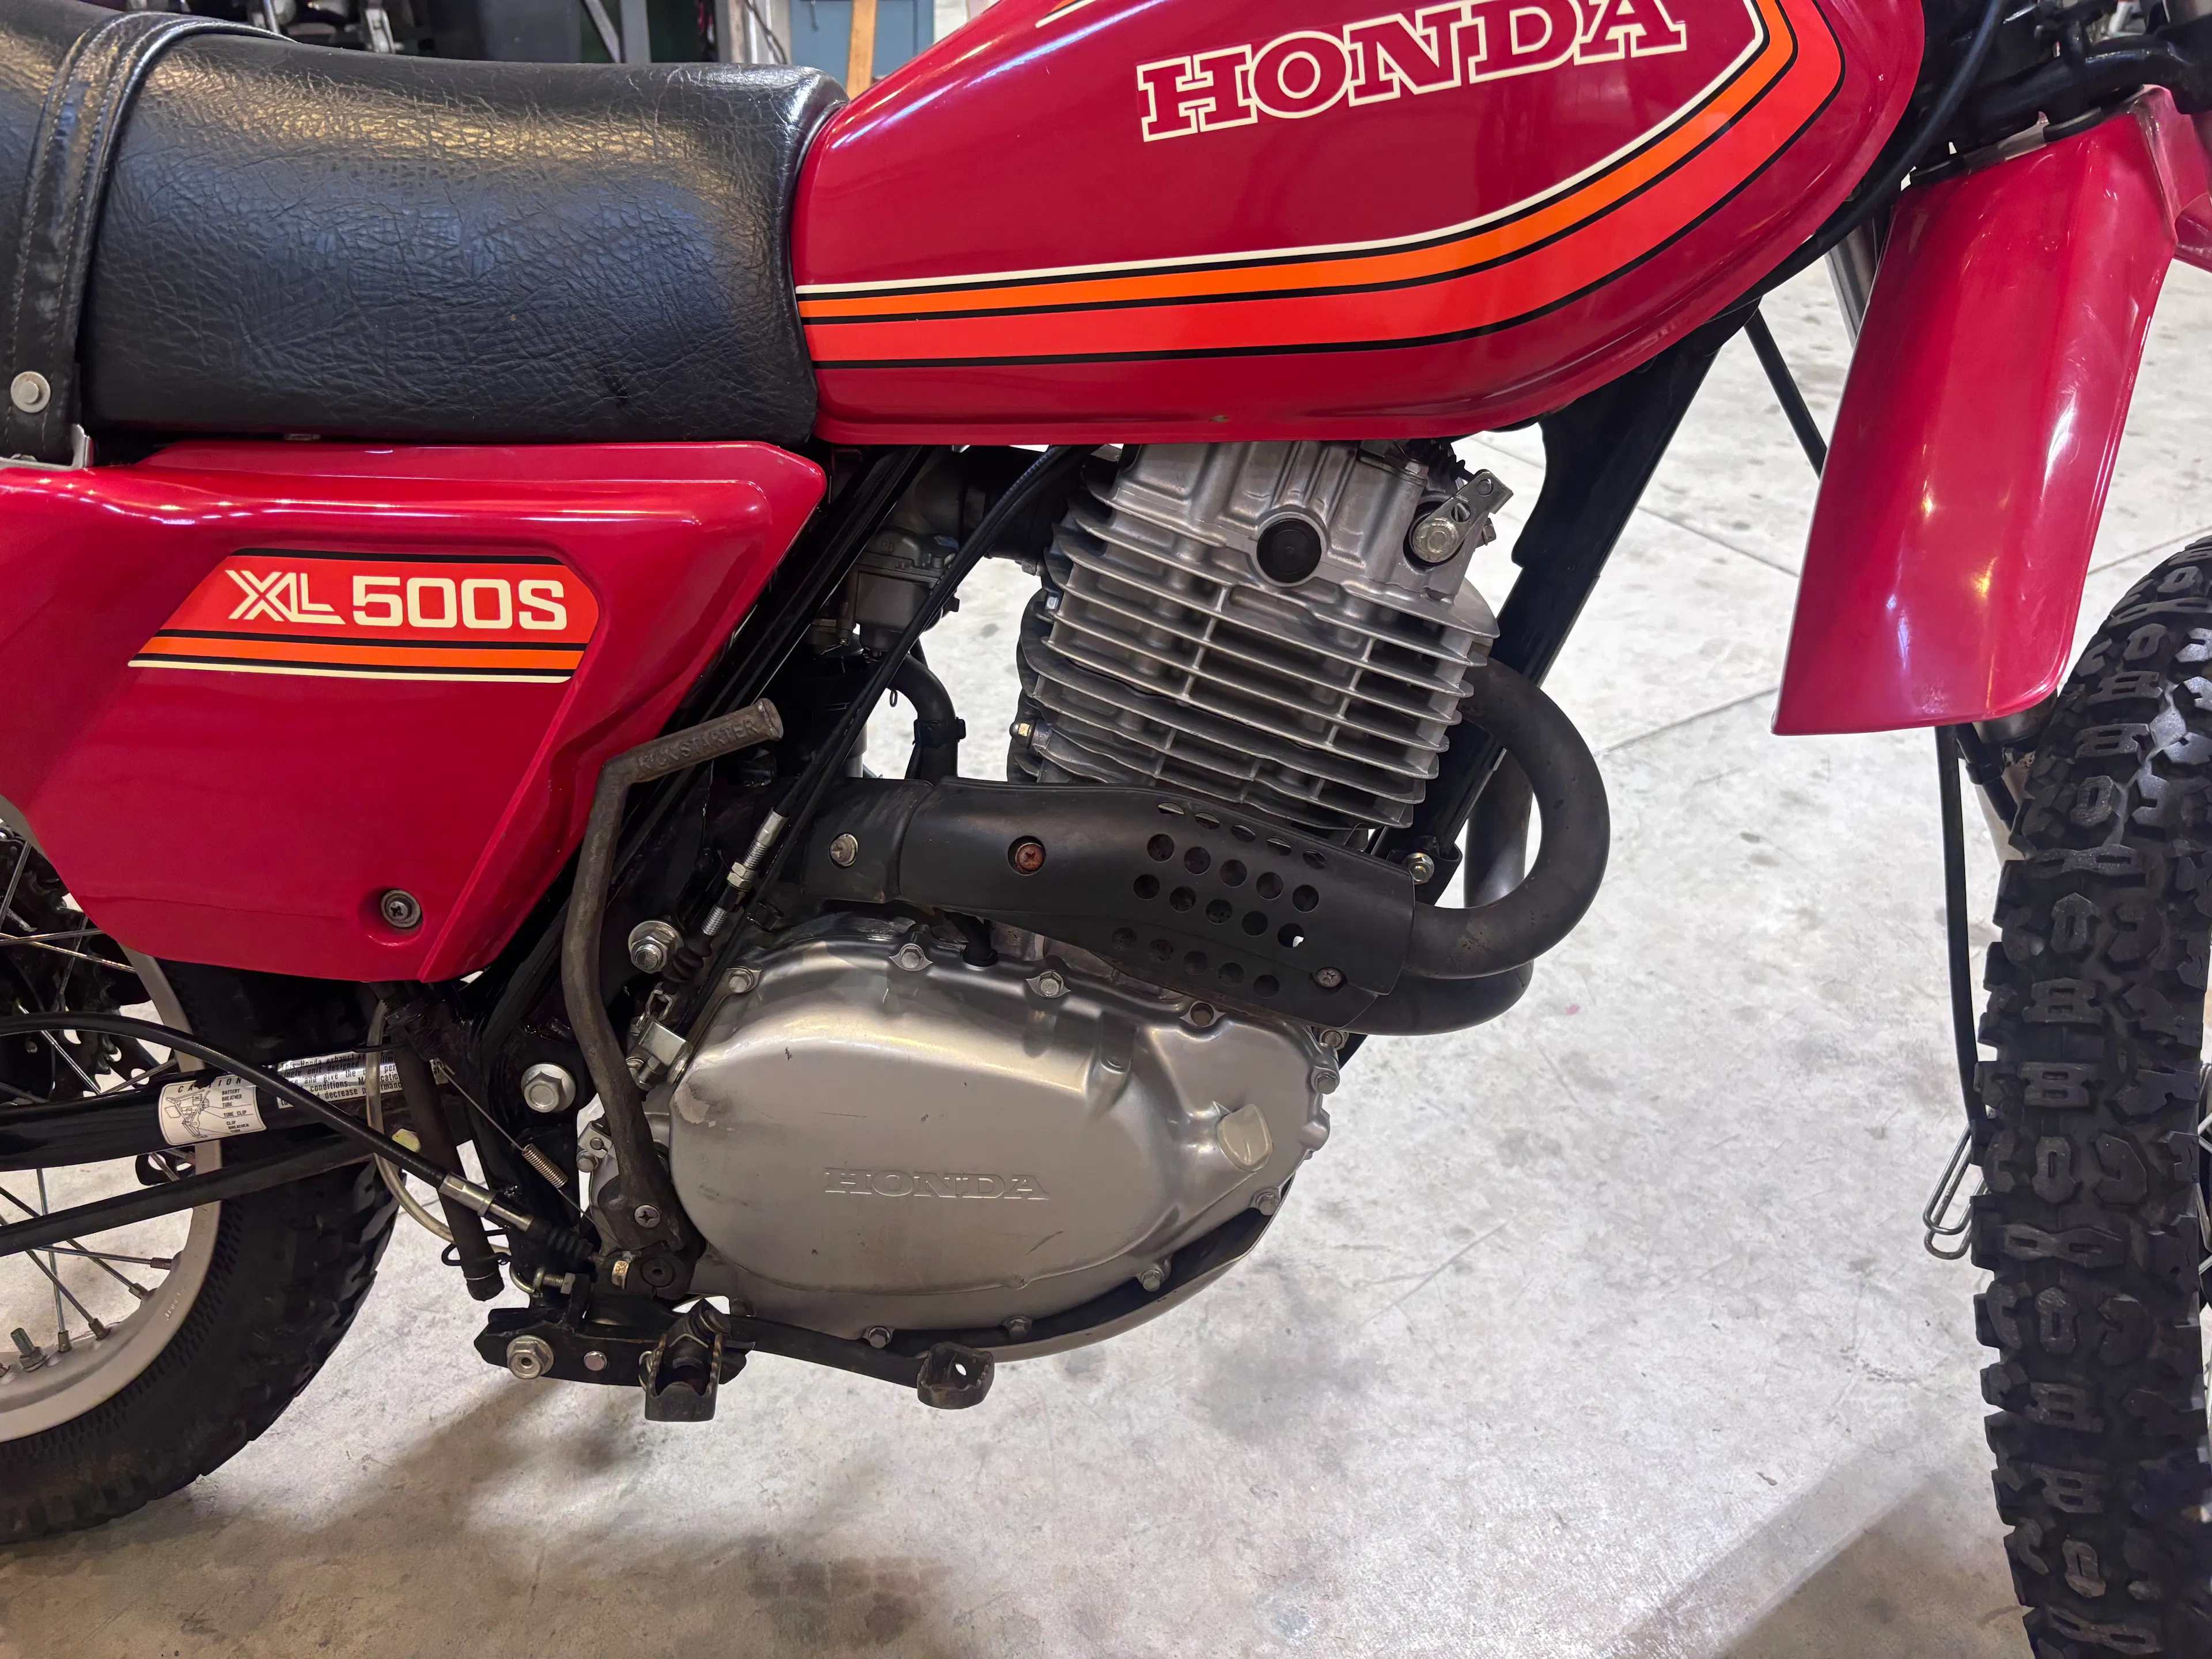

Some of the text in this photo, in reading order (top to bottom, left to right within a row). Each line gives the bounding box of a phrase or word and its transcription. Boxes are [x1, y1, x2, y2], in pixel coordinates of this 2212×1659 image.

[1137, 0, 1687, 142] HONDA
[225, 569, 567, 630] XL 500S
[301, 1058, 322, 1067] Honda
[327, 1053, 354, 1063] exhaust
[308, 1066, 322, 1074] unit
[327, 1061, 359, 1071] designed
[304, 1075, 317, 1084] and
[324, 1072, 339, 1082] give
[346, 1069, 356, 1077] the
[177, 1077, 242, 1093] CAION
[310, 1080, 351, 1092] conditions.
[325, 1088, 358, 1099] decrease
[823, 1166, 1050, 1200] HONDA
